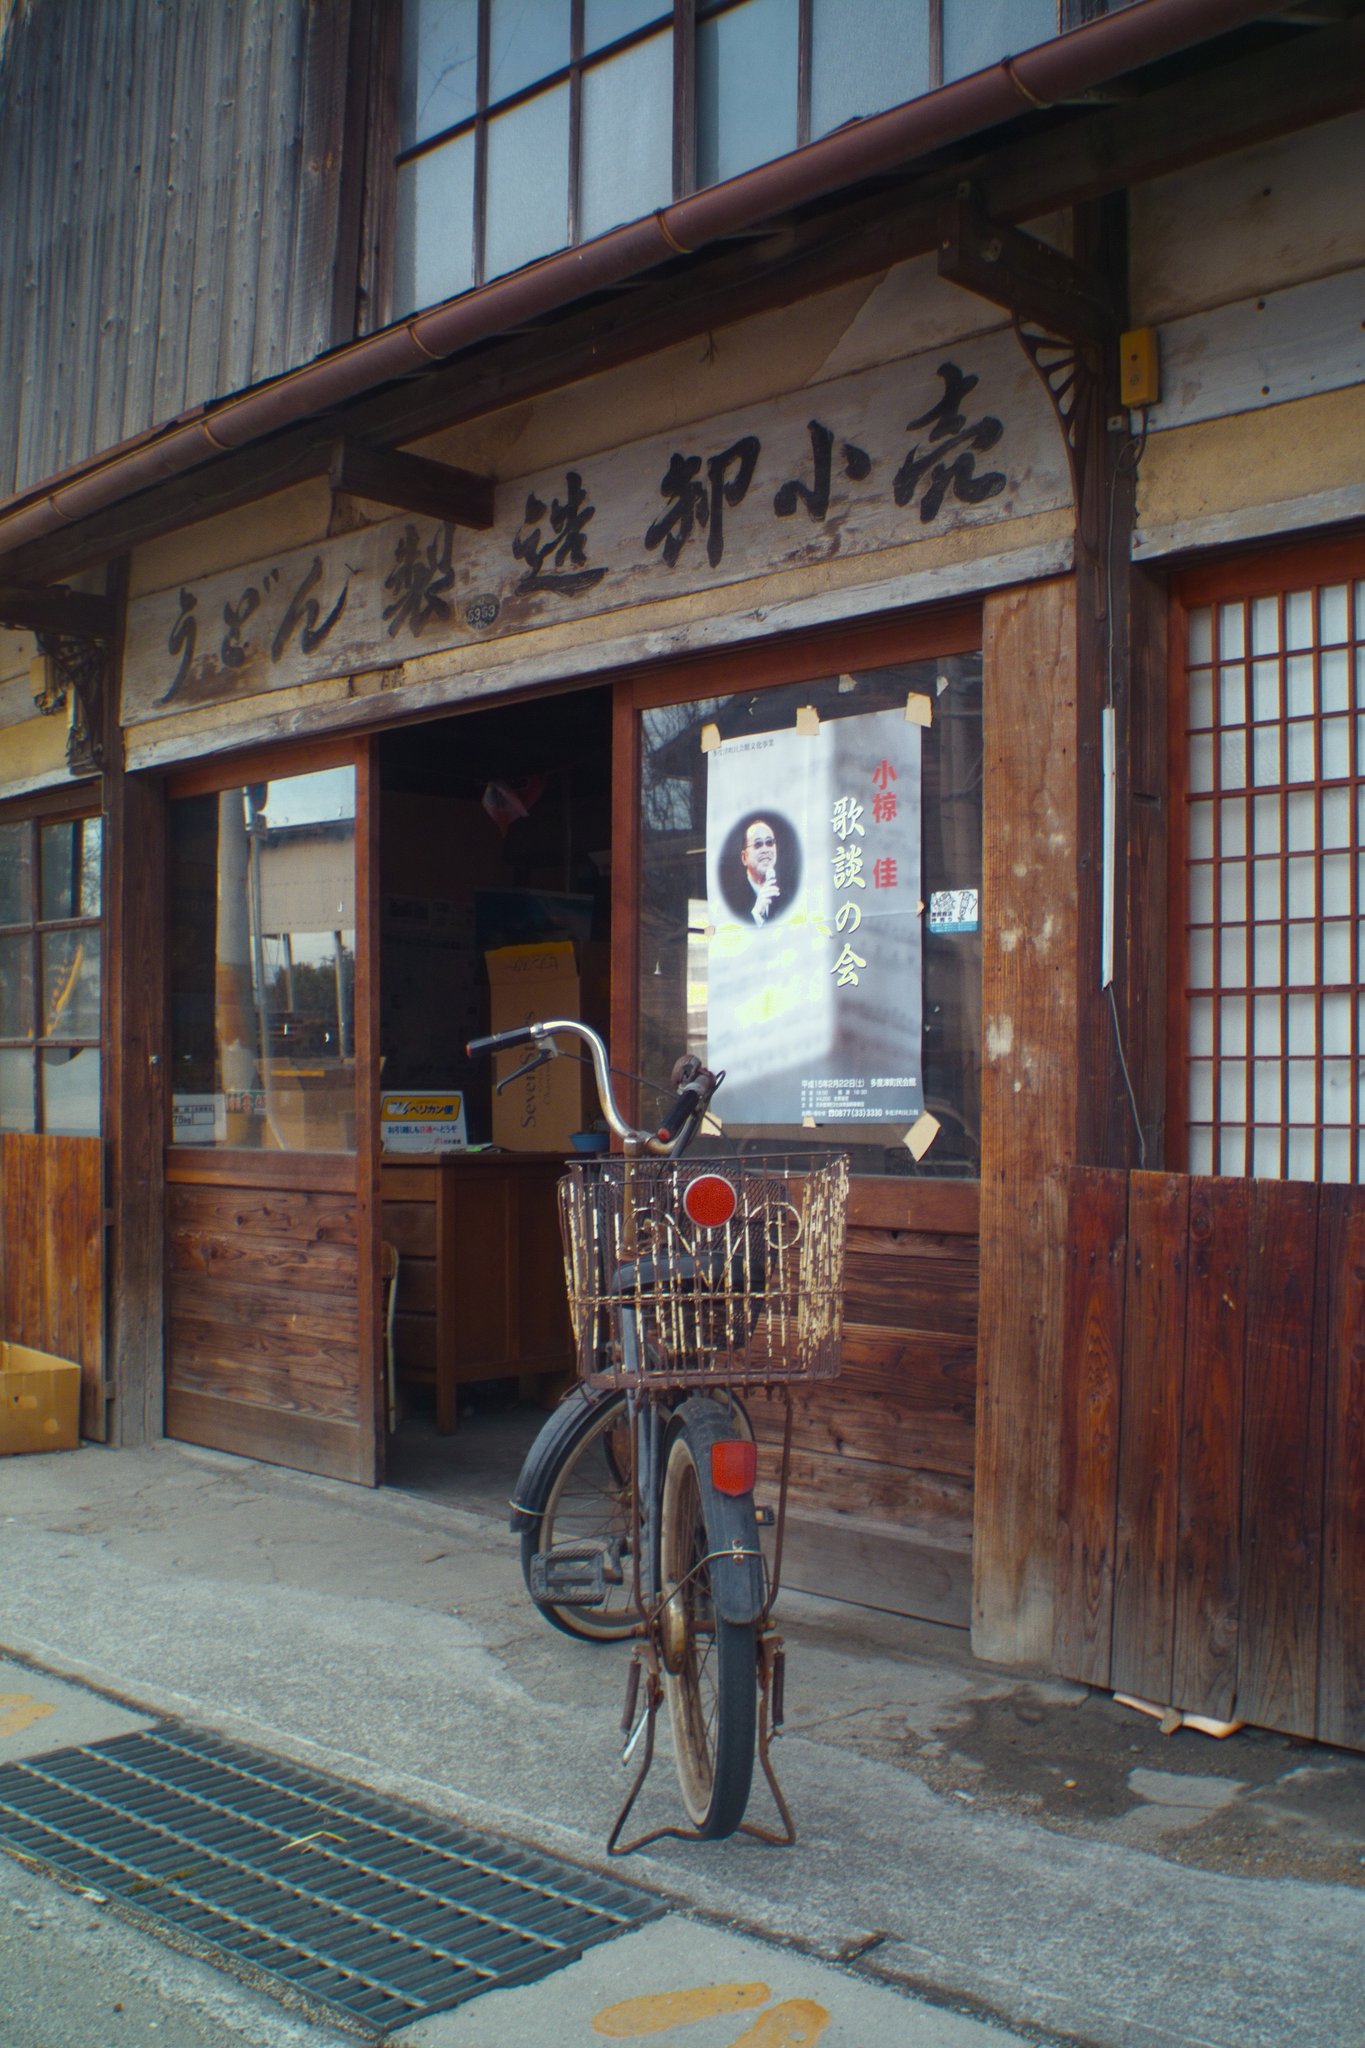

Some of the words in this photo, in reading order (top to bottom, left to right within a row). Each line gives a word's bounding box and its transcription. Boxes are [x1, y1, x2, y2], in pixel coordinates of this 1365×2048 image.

[831, 796, 867, 988] 歌談の会
[873, 857, 898, 889] 佳
